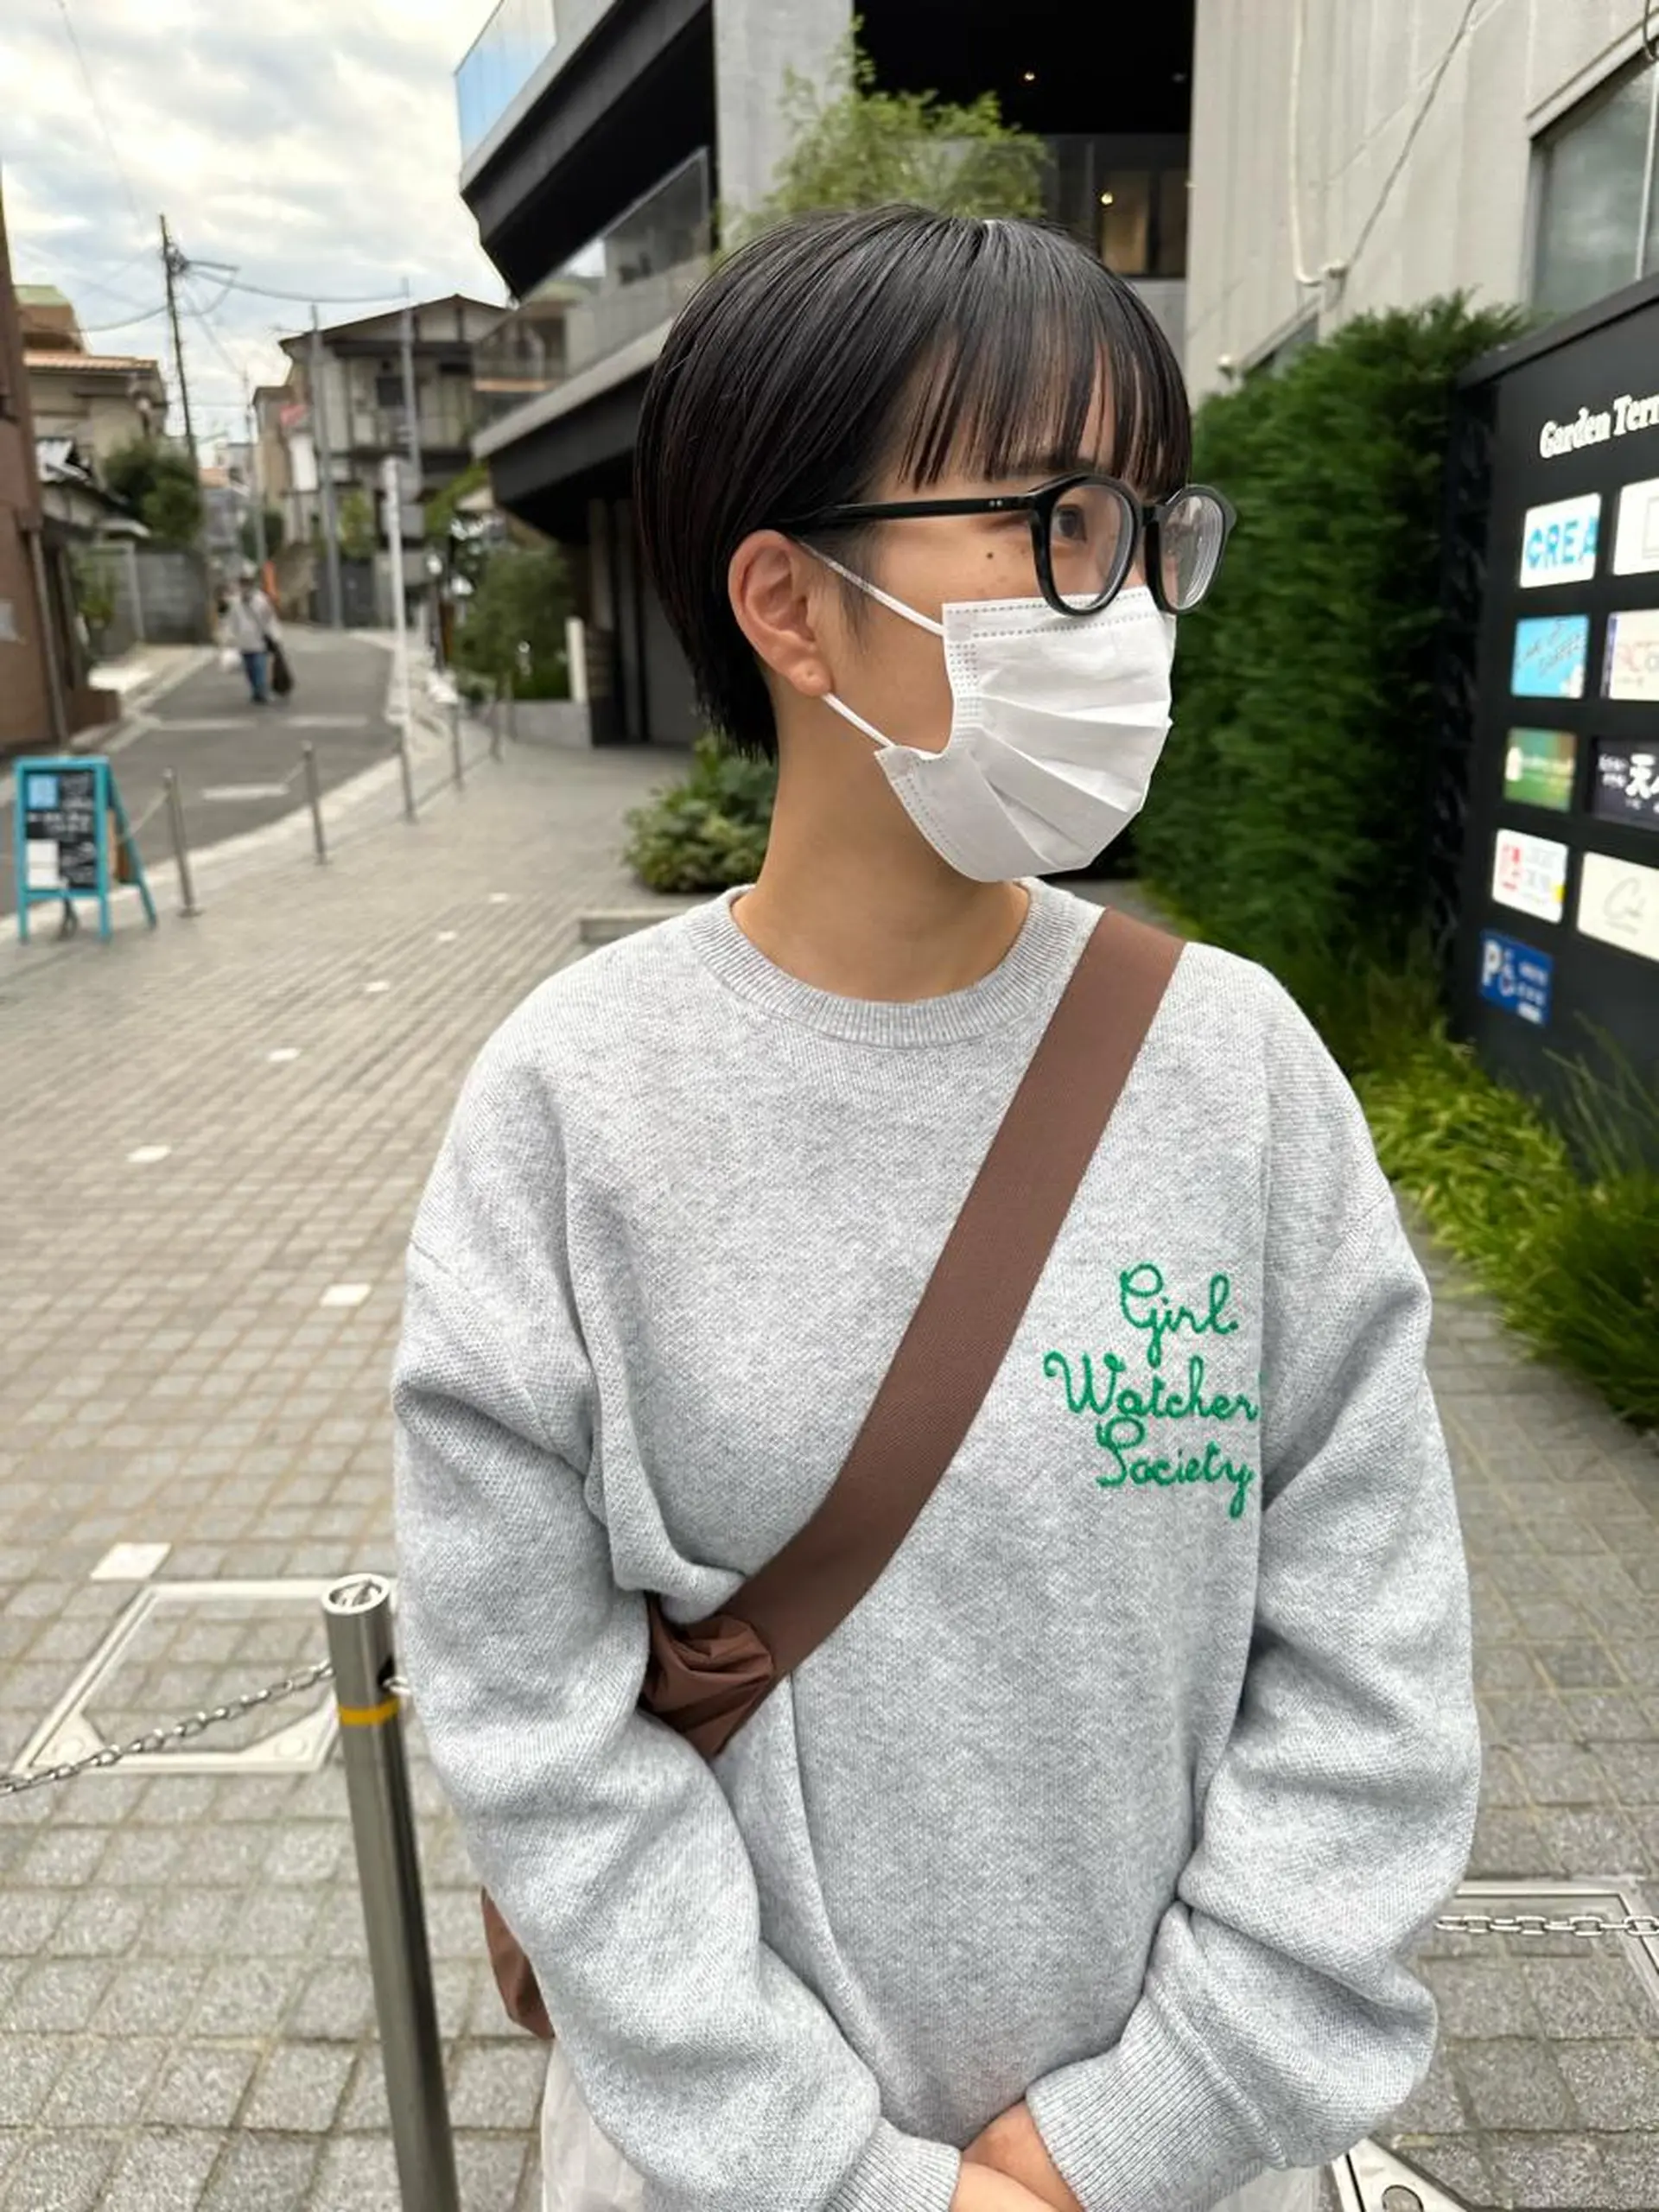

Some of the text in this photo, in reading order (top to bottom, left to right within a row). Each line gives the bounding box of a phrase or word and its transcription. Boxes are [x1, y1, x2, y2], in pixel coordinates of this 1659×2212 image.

[1540, 405, 1611, 459] Garden
[1483, 938, 1502, 987] P
[1120, 1261, 1239, 1368] Girl
[1095, 1414, 1255, 1519] Society
